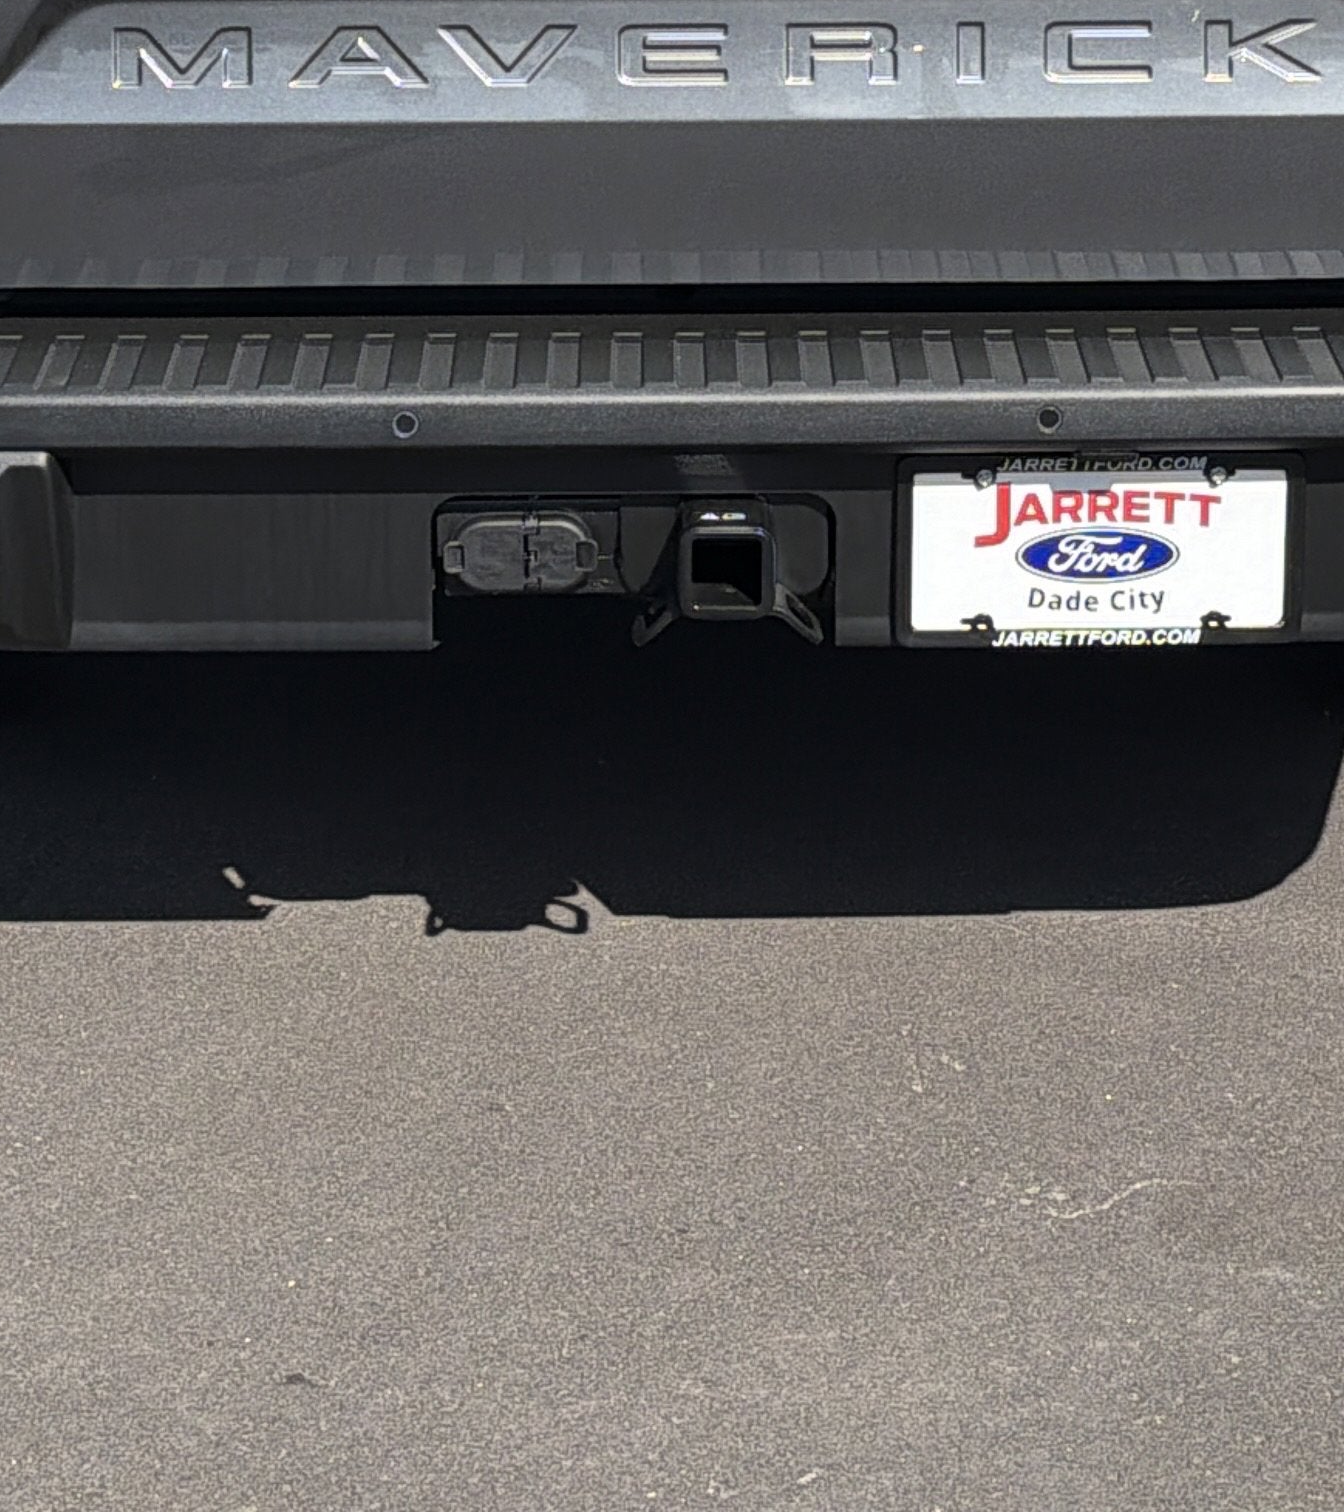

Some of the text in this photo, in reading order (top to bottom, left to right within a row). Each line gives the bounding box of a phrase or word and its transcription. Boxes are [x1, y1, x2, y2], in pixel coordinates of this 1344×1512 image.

[111, 17, 1323, 88] MAVERICK
[974, 482, 1222, 547] JARRETT
[1048, 534, 1145, 573] Ford
[1027, 587, 1166, 614] Dade City
[991, 628, 1202, 648] JARRETTFORD.COM
